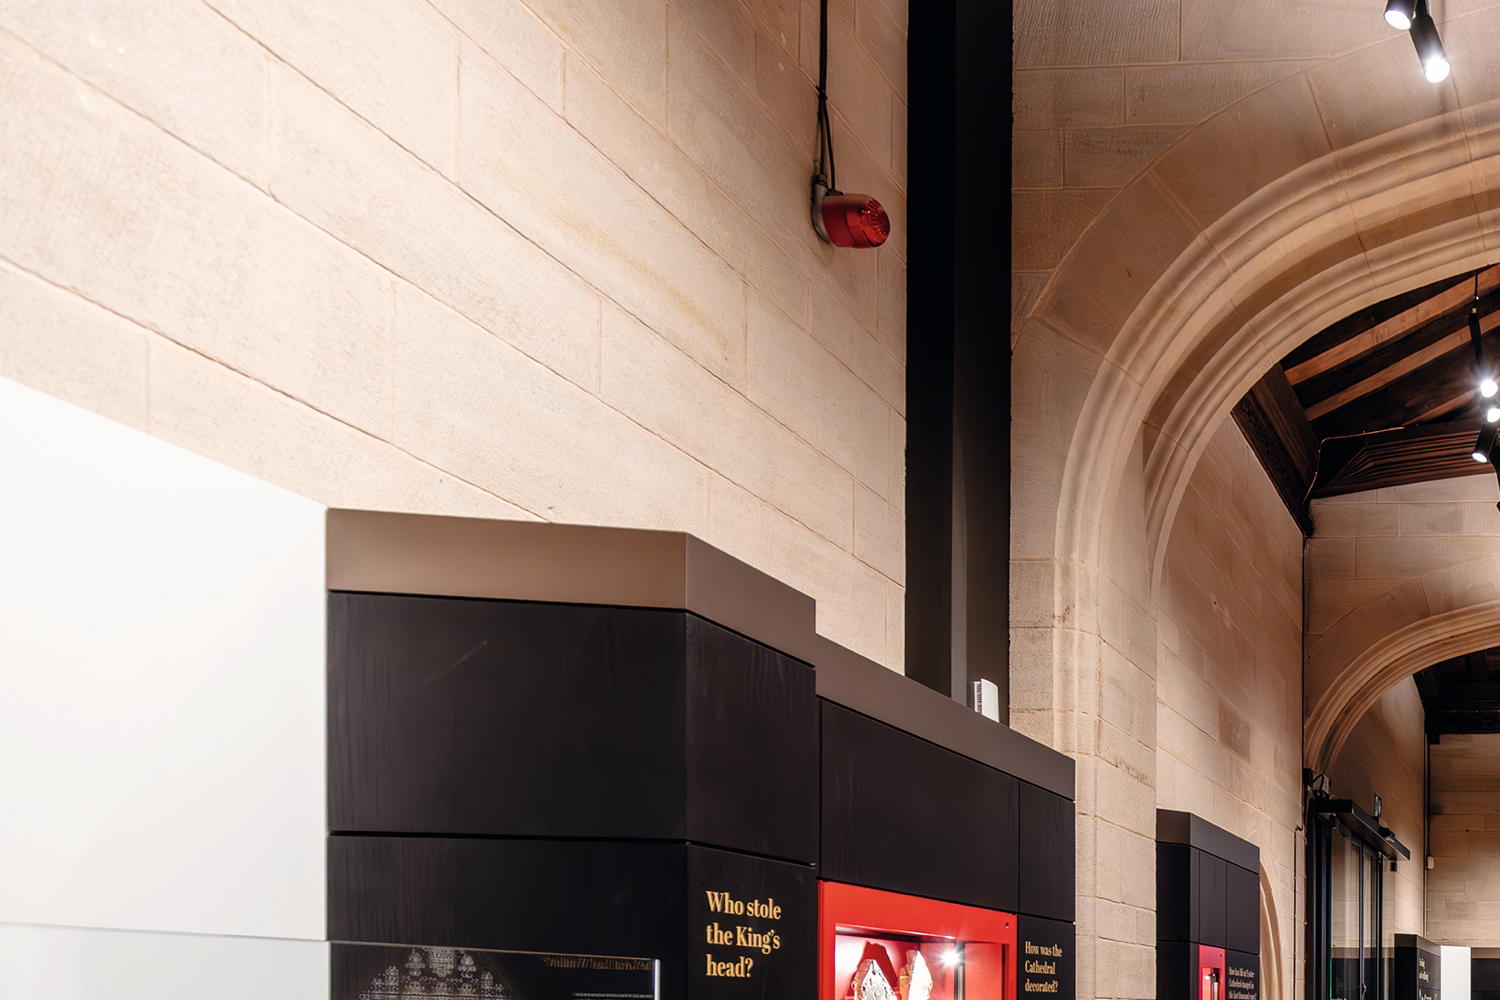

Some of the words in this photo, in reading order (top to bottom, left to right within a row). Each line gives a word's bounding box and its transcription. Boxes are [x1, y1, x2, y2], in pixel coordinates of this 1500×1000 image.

[706, 891, 744, 915] Who
[747, 898, 781, 919] stole
[706, 922, 733, 945] the
[736, 926, 780, 954] King’s
[1025, 941, 1038, 954] How
[1040, 947, 1051, 956] was
[1053, 944, 1062, 957] the
[706, 954, 753, 977] head?
[1025, 960, 1055, 974] Cathedral
[1025, 978, 1058, 992] decorated?
